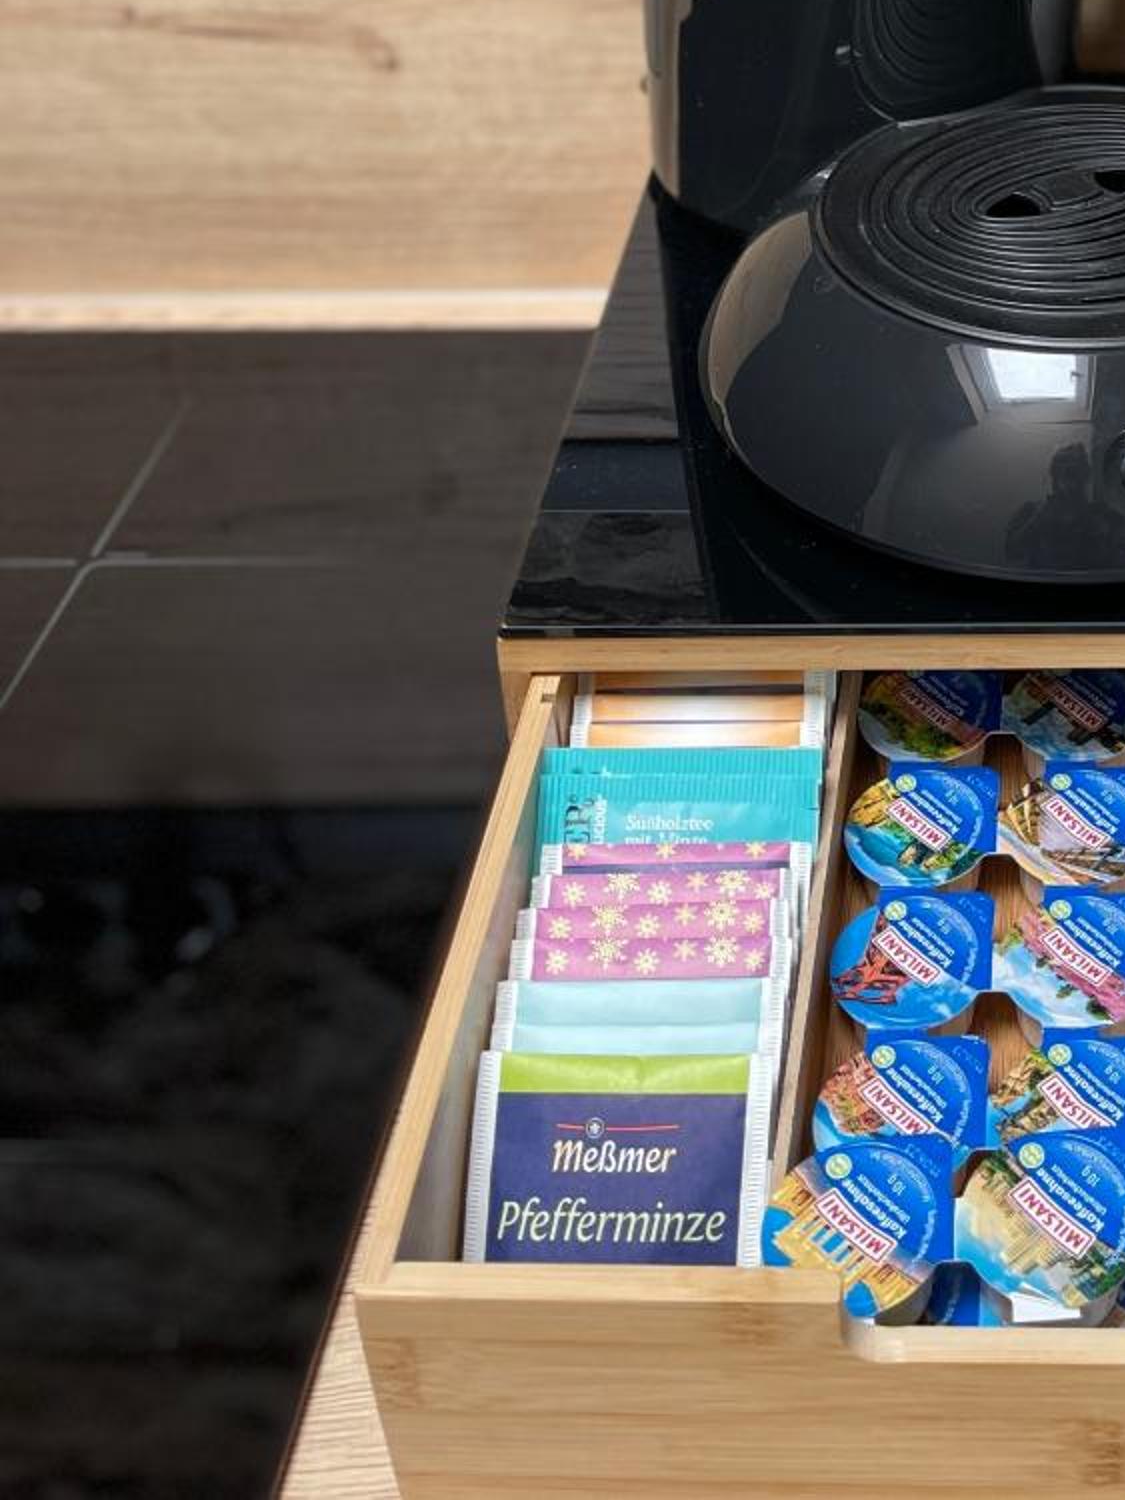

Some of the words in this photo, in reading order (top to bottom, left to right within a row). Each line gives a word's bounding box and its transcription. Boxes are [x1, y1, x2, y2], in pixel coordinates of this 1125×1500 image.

[1053, 689, 1100, 727] MILSANI
[893, 803, 942, 845] MILSANI
[1049, 800, 1100, 846] MILSANI
[881, 934, 933, 980] MILSANI
[897, 919, 951, 967] Kaffeesahne
[1048, 933, 1102, 980] MILSANI
[1063, 919, 1120, 968] Kaffeesahne
[868, 1086, 922, 1135] MILSANI
[885, 1068, 943, 1121] Kaffeesahne
[1062, 1064, 1124, 1120] Kaffeesahne
[552, 1140, 677, 1173] Meßmer
[1087, 1172, 1100, 1187] 10
[840, 1179, 906, 1238] Kaffeesahne
[892, 1182, 905, 1196] 10
[1034, 1168, 1105, 1231] Kaffeesahne
[495, 1197, 726, 1242] Pfefferminze
[824, 1199, 886, 1254] MILSANI
[1018, 1188, 1084, 1248] MILSANI
